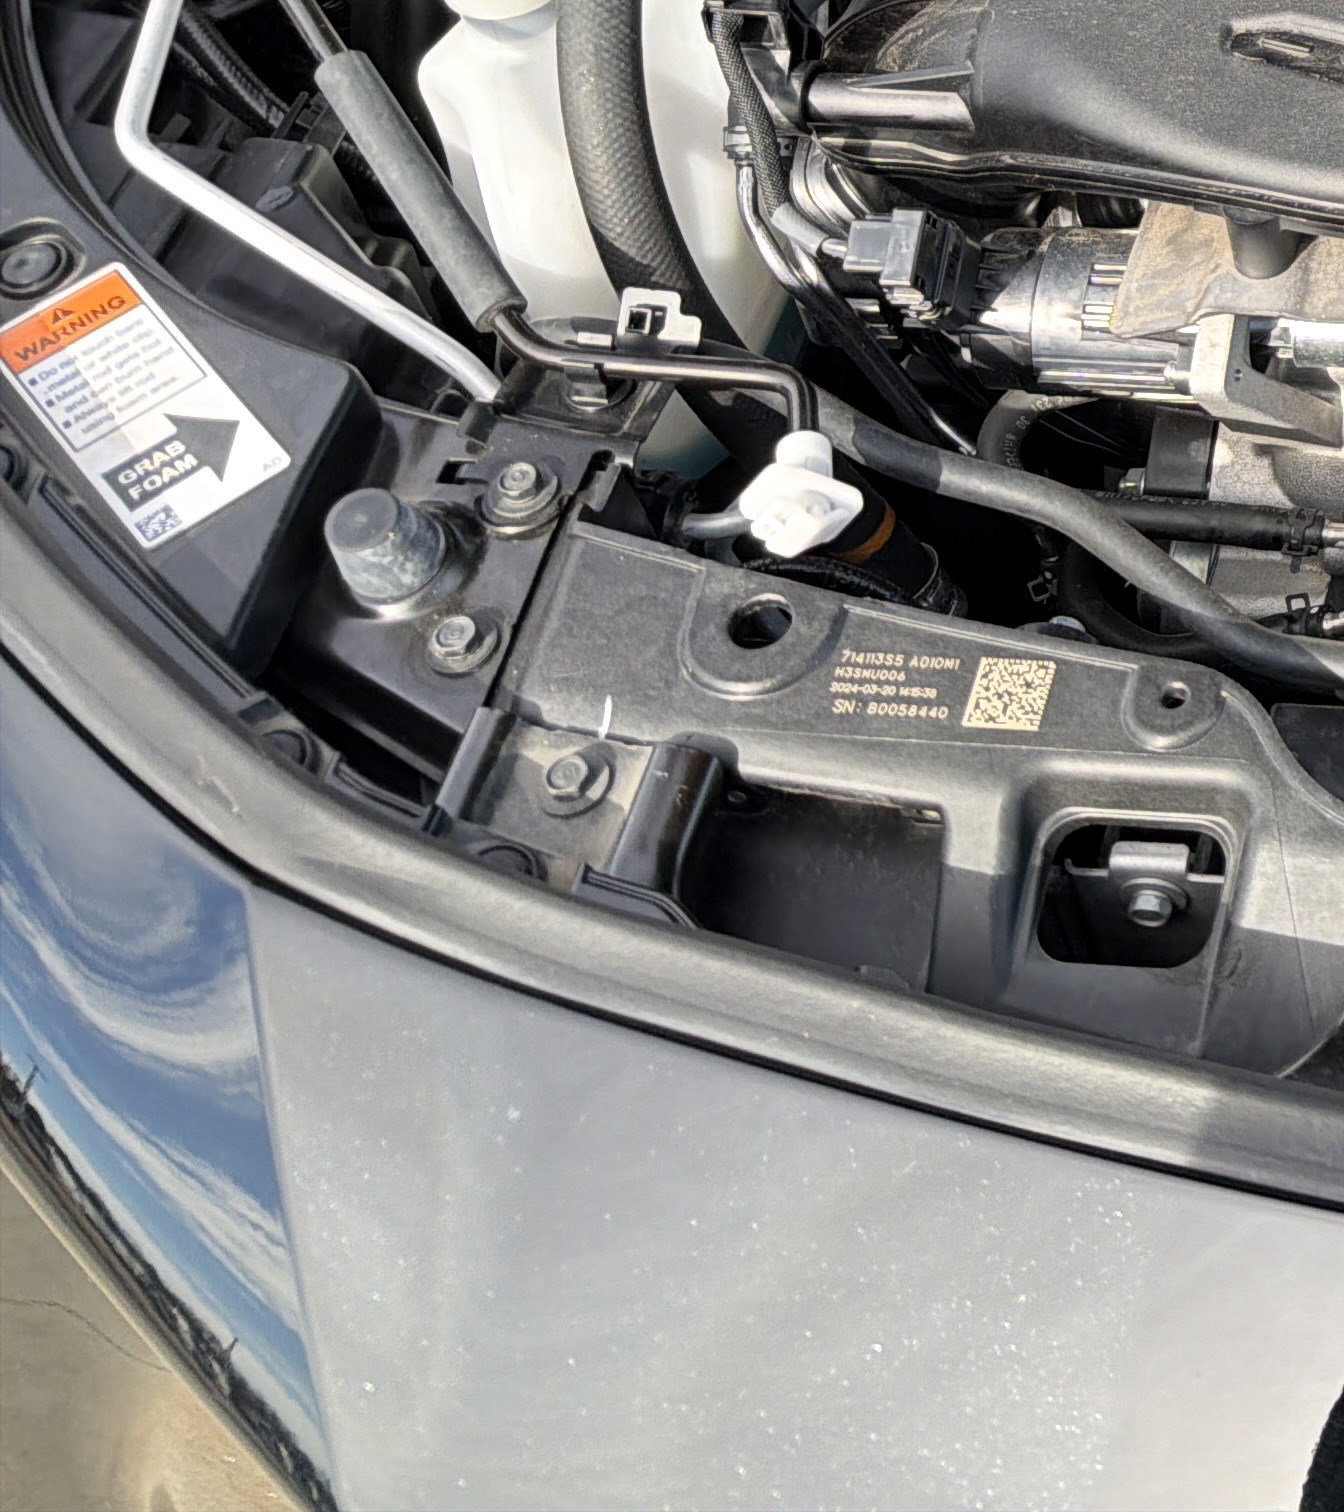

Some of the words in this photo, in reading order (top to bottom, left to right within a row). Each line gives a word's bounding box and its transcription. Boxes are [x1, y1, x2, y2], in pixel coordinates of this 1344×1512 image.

[15, 294, 126, 362] WARNING
[118, 439, 186, 486] GRAB
[128, 452, 199, 501] FOAM
[832, 699, 861, 715] SN:
